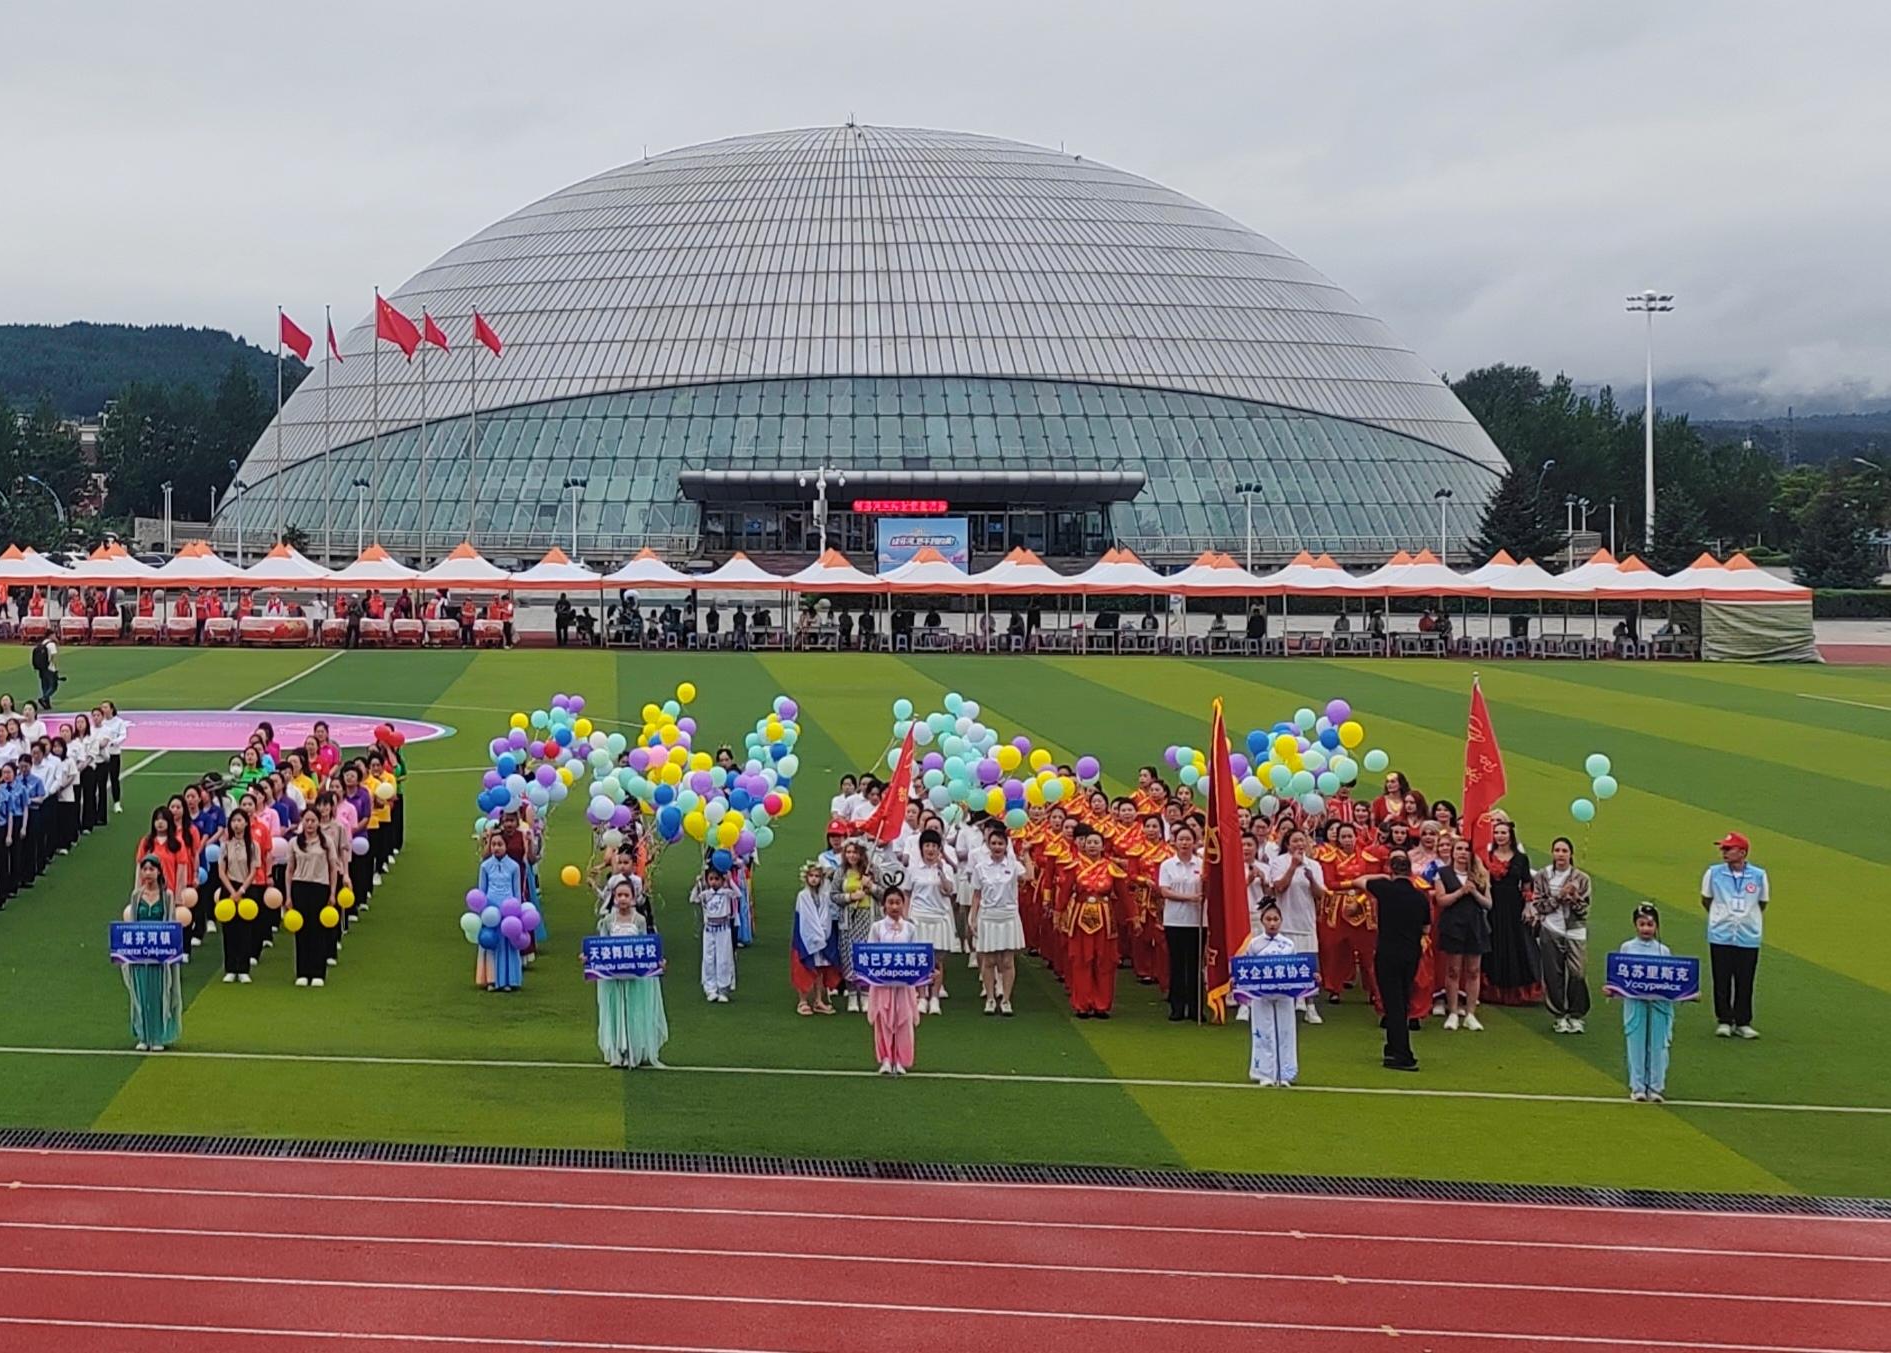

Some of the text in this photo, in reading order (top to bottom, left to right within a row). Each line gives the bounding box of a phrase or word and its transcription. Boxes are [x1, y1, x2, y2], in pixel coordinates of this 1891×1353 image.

[122, 930, 172, 946] 绥芬河镇
[588, 943, 658, 961] 天姿舞蹈学校
[858, 951, 929, 967] 哈巴罗夫斯克
[868, 967, 921, 978] Хабаровск
[1237, 963, 1311, 980] 女企业家协会
[1616, 962, 1690, 983] 乌苏里斯克
[1623, 979, 1683, 992] Уссурийск
